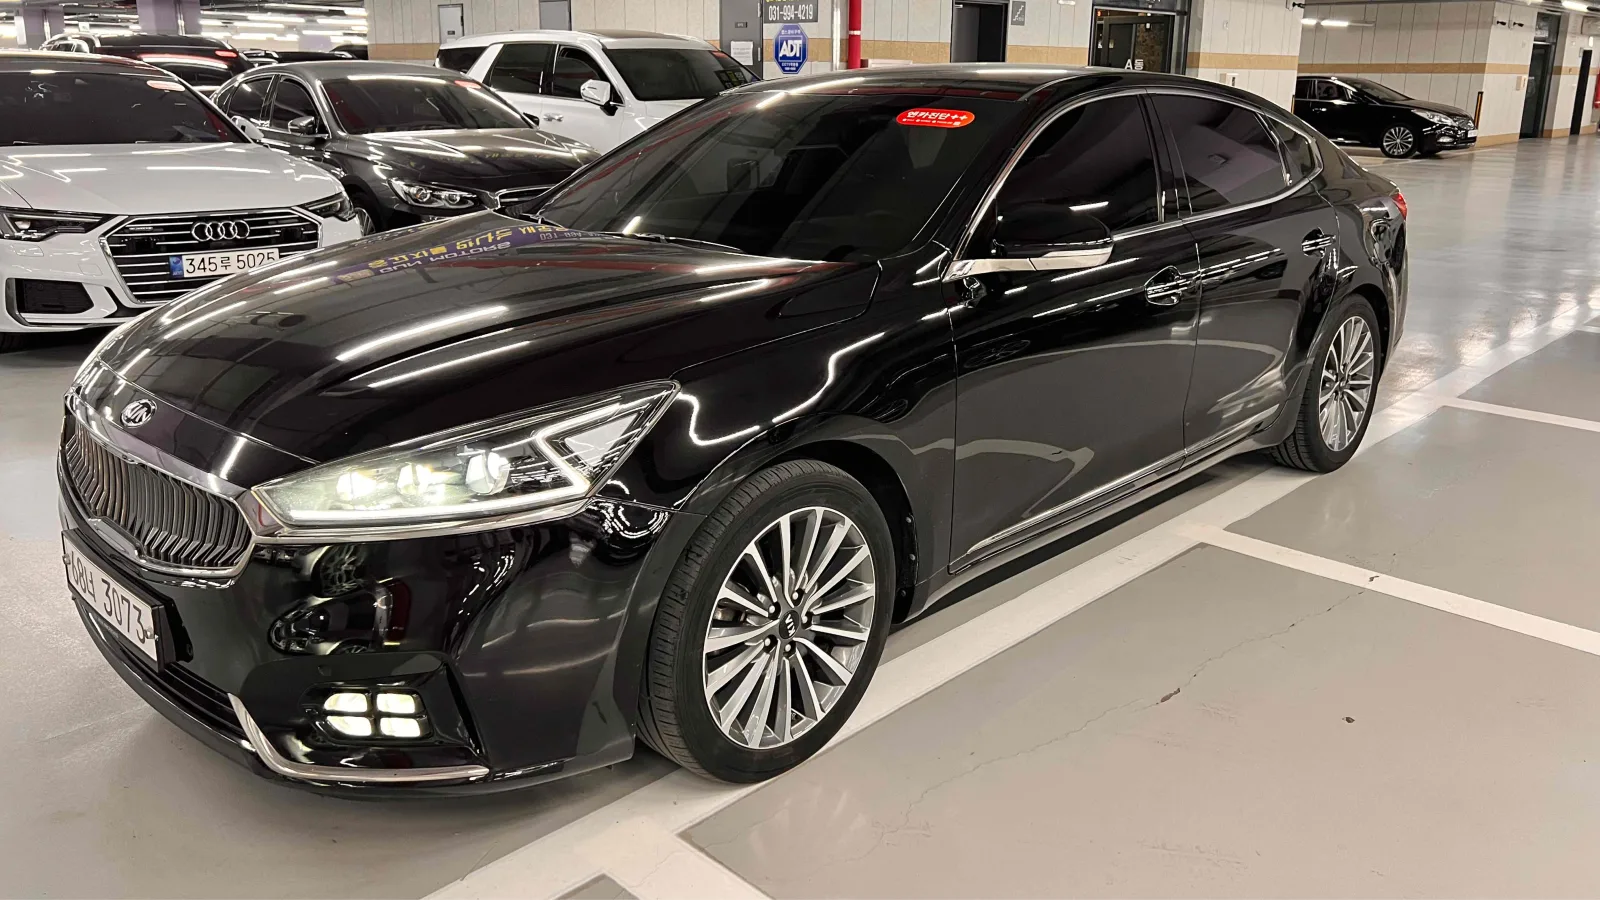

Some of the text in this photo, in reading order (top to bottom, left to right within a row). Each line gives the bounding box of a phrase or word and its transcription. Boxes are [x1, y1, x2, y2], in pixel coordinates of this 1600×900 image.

[768, 4, 814, 21] 031-994-4219
[779, 39, 803, 57] ADT
[185, 256, 232, 274] 345루
[101, 577, 146, 645] 3073
